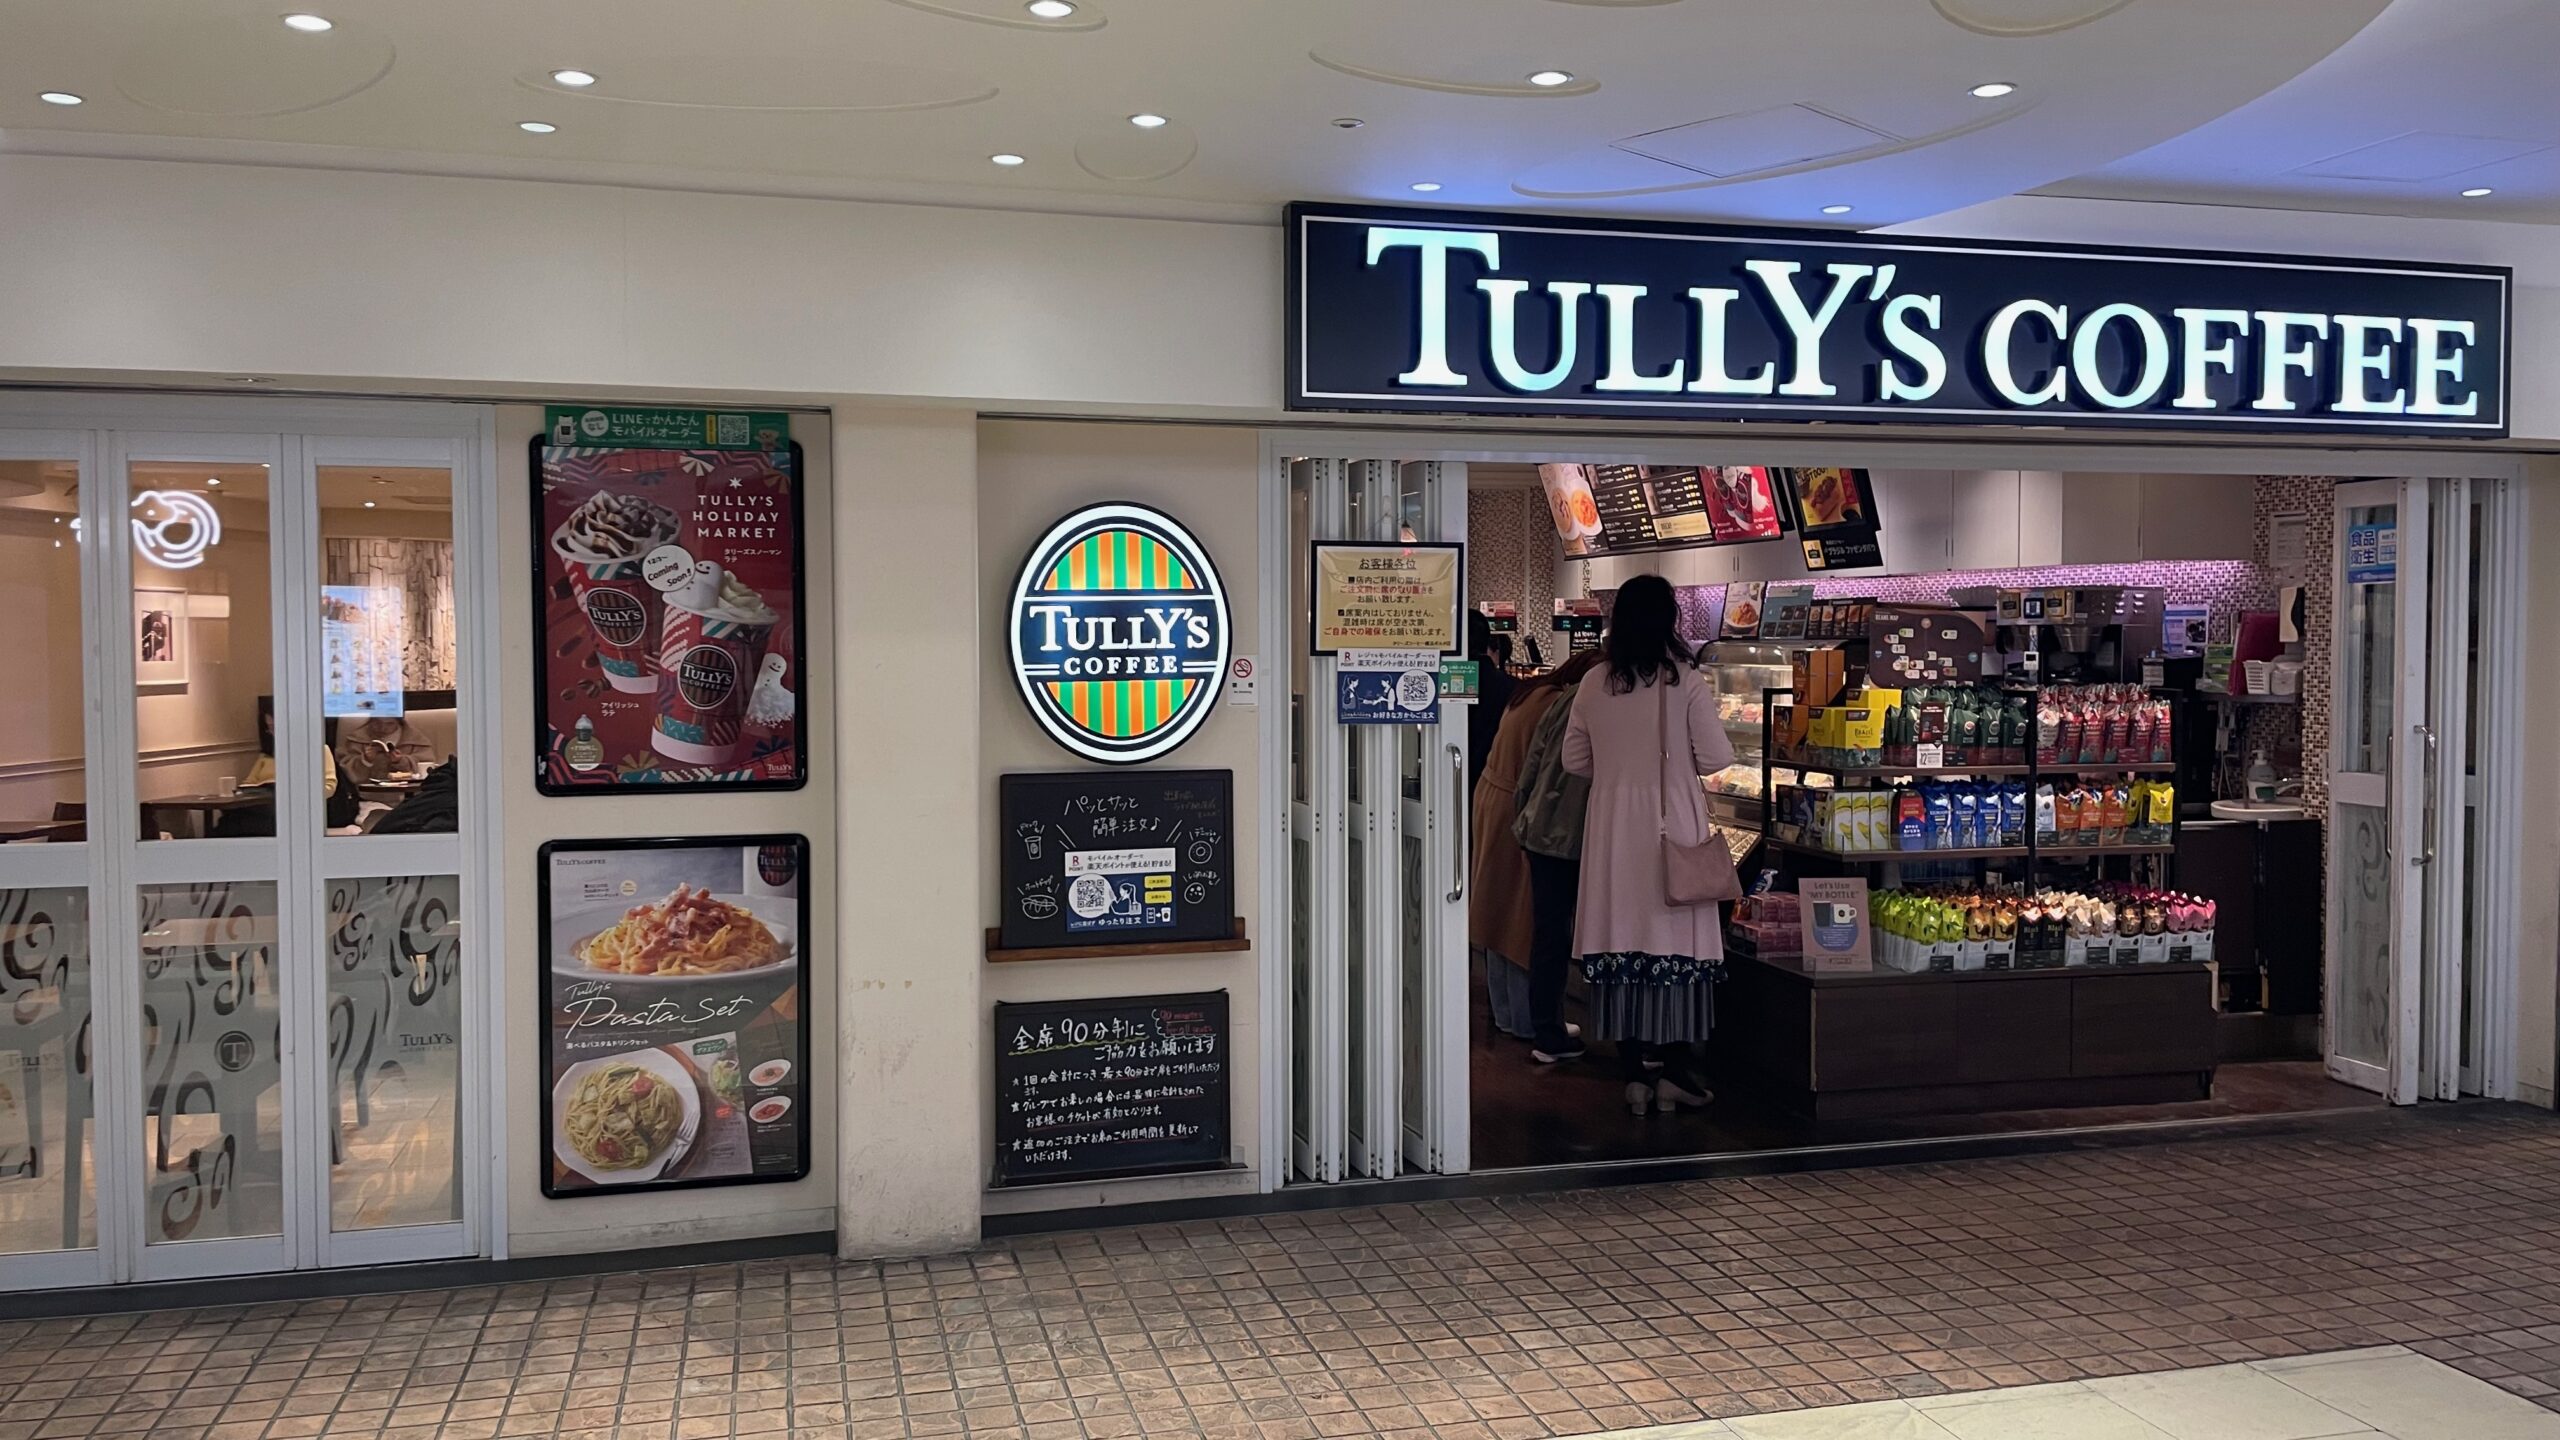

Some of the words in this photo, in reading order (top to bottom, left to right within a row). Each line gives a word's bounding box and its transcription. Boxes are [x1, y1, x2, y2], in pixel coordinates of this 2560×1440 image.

[1366, 226, 1947, 402] TULLY'S
[1984, 299, 2478, 416] COFFEE
[612, 426, 701, 437] モバイルオーダー
[697, 495, 774, 507] TULLY'S
[692, 511, 779, 522] HOLIDAY
[697, 527, 776, 538] MARKET
[2351, 530, 2375, 547] 食品
[1359, 557, 1417, 570] お客様各位
[647, 562, 679, 581] Coming
[1028, 604, 1211, 651] TULLY'S
[1063, 655, 1178, 675] COFFEE
[682, 663, 732, 685] TULLY'S
[688, 679, 721, 690] COFFEE
[601, 709, 616, 717] ラテ
[1372, 711, 1436, 720] お好きな方からご注文
[1064, 795, 1139, 816] パッとサッと
[1098, 917, 1142, 926] ゆったり注文
[563, 996, 680, 1040] Pasta
[681, 994, 753, 1023] Set
[400, 1033, 453, 1047] TULLY'S
[1094, 1037, 1216, 1062] ご協力をお願いします
[1025, 1149, 1072, 1164] いただけます。
